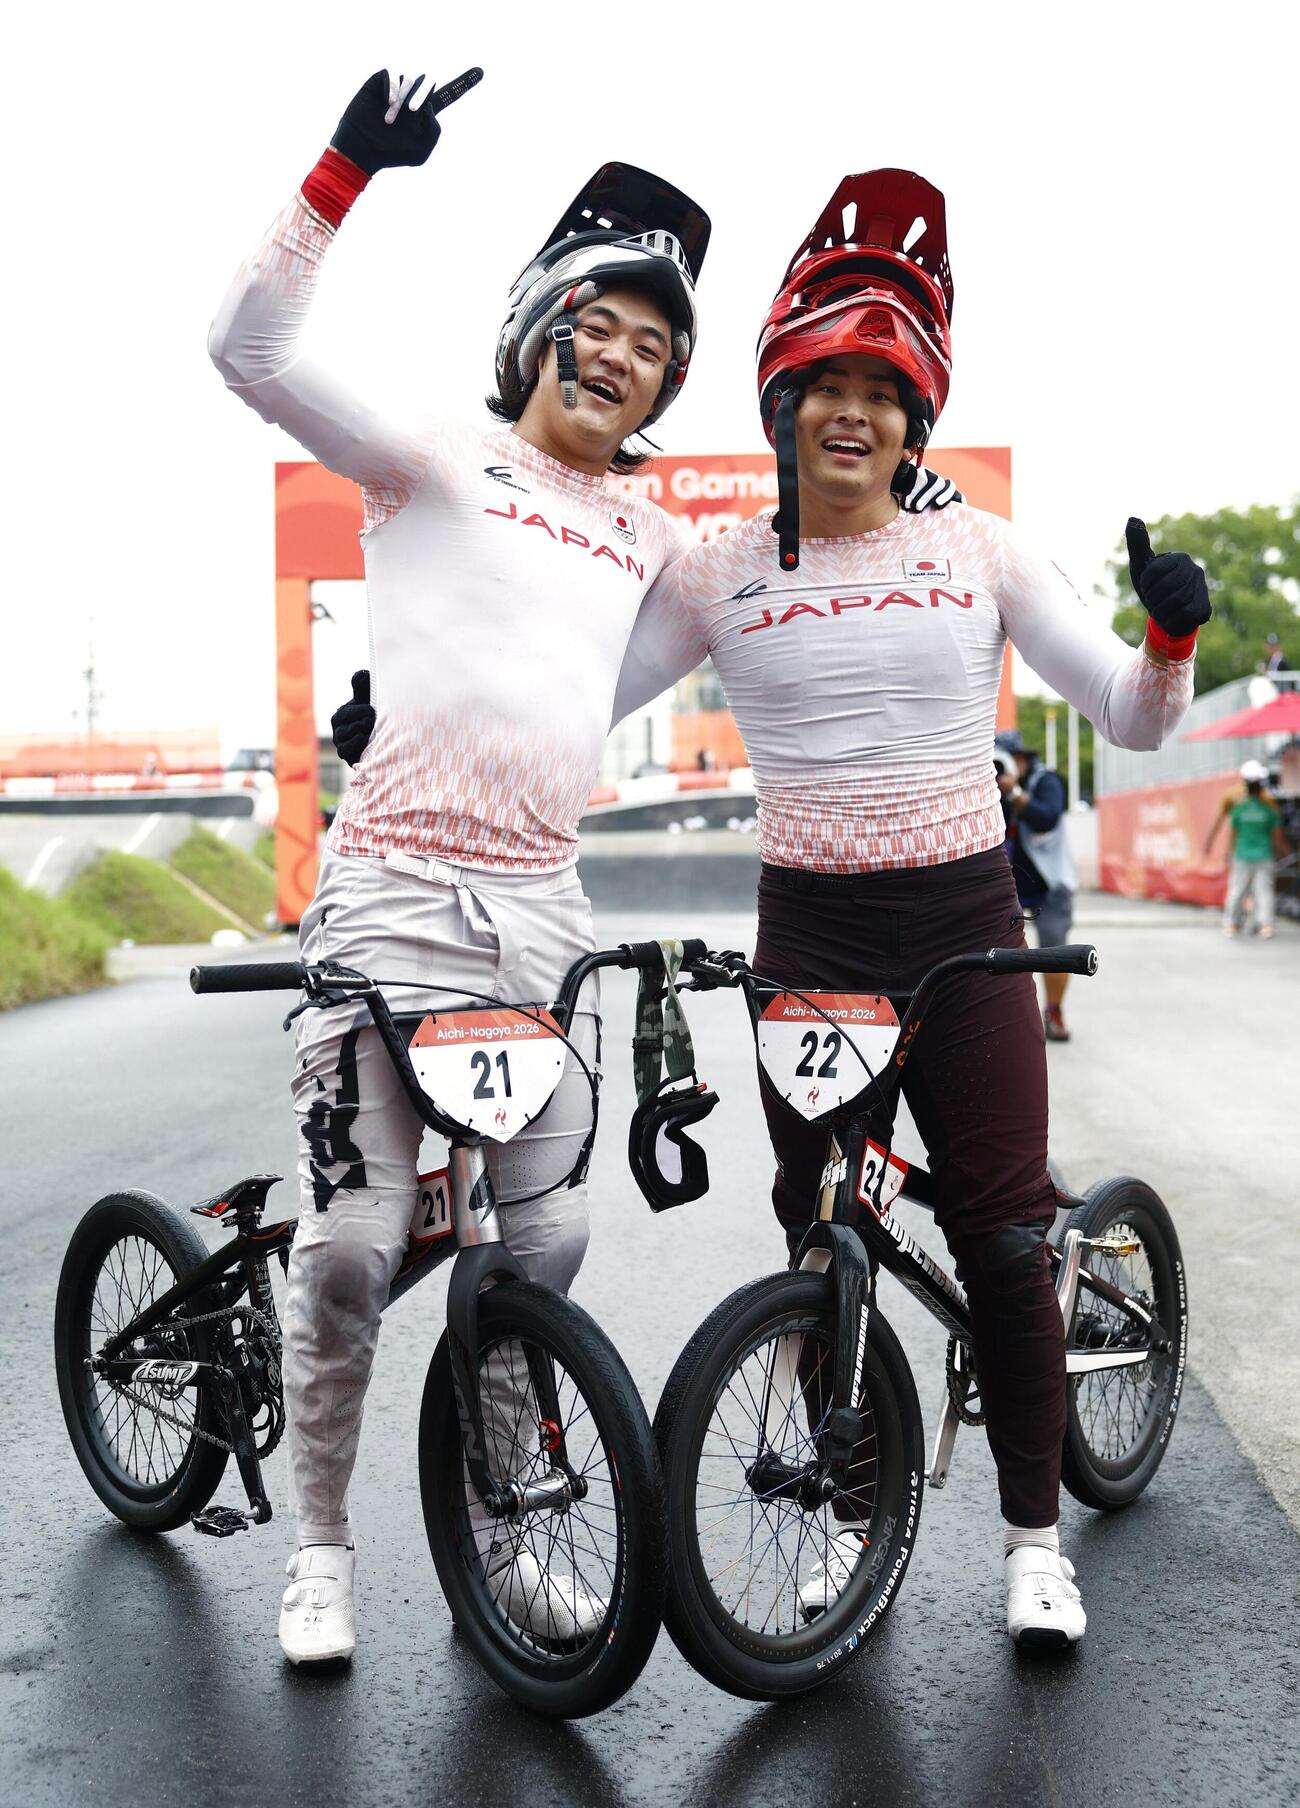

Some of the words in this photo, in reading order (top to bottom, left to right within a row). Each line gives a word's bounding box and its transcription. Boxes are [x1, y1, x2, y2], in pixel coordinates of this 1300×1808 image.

[483, 502, 644, 581] JAPAN
[740, 588, 973, 635] JAPAN
[437, 1026, 511, 1039] Aichi-Nagoya
[514, 1023, 540, 1035] 2026
[850, 1008, 876, 1019] 2026
[470, 1050, 512, 1100] 21
[795, 1030, 842, 1079] 22
[422, 1186, 447, 1228] 21
[905, 1490, 917, 1538] TIOGA
[859, 1546, 909, 1637] POWERBLOCK
